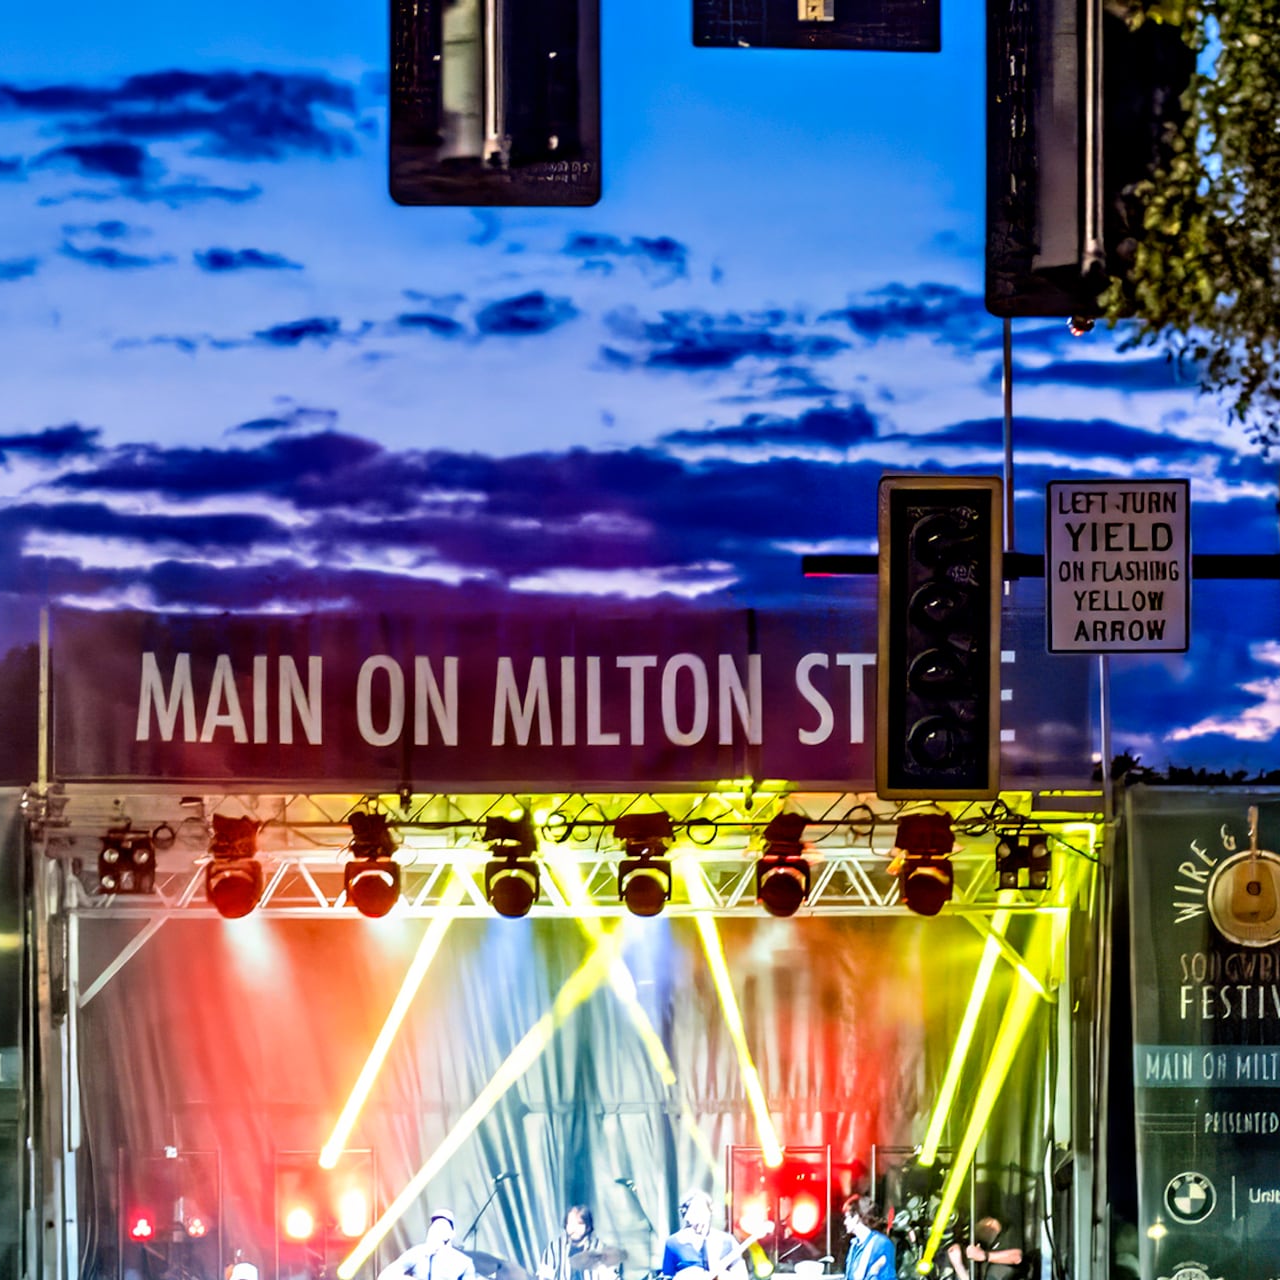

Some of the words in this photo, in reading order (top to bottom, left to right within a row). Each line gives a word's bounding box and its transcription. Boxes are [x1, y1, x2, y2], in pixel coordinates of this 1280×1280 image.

[1059, 491, 1108, 514] LEFT
[1117, 491, 1177, 514] TURN
[1065, 522, 1173, 552] YIELD
[1058, 560, 1084, 582] ON
[1091, 560, 1179, 582] FLASHING
[1074, 590, 1164, 612] YELLOW
[1074, 619, 1166, 642] ARROW
[136, 651, 322, 745] MAIN
[356, 654, 459, 747] ON
[491, 652, 763, 747] MILTON
[1173, 839, 1218, 924] WIRE
[1145, 1052, 1193, 1081] MAIN
[1202, 1052, 1228, 1081] ON
[1203, 1112, 1280, 1133] PRESENTED
